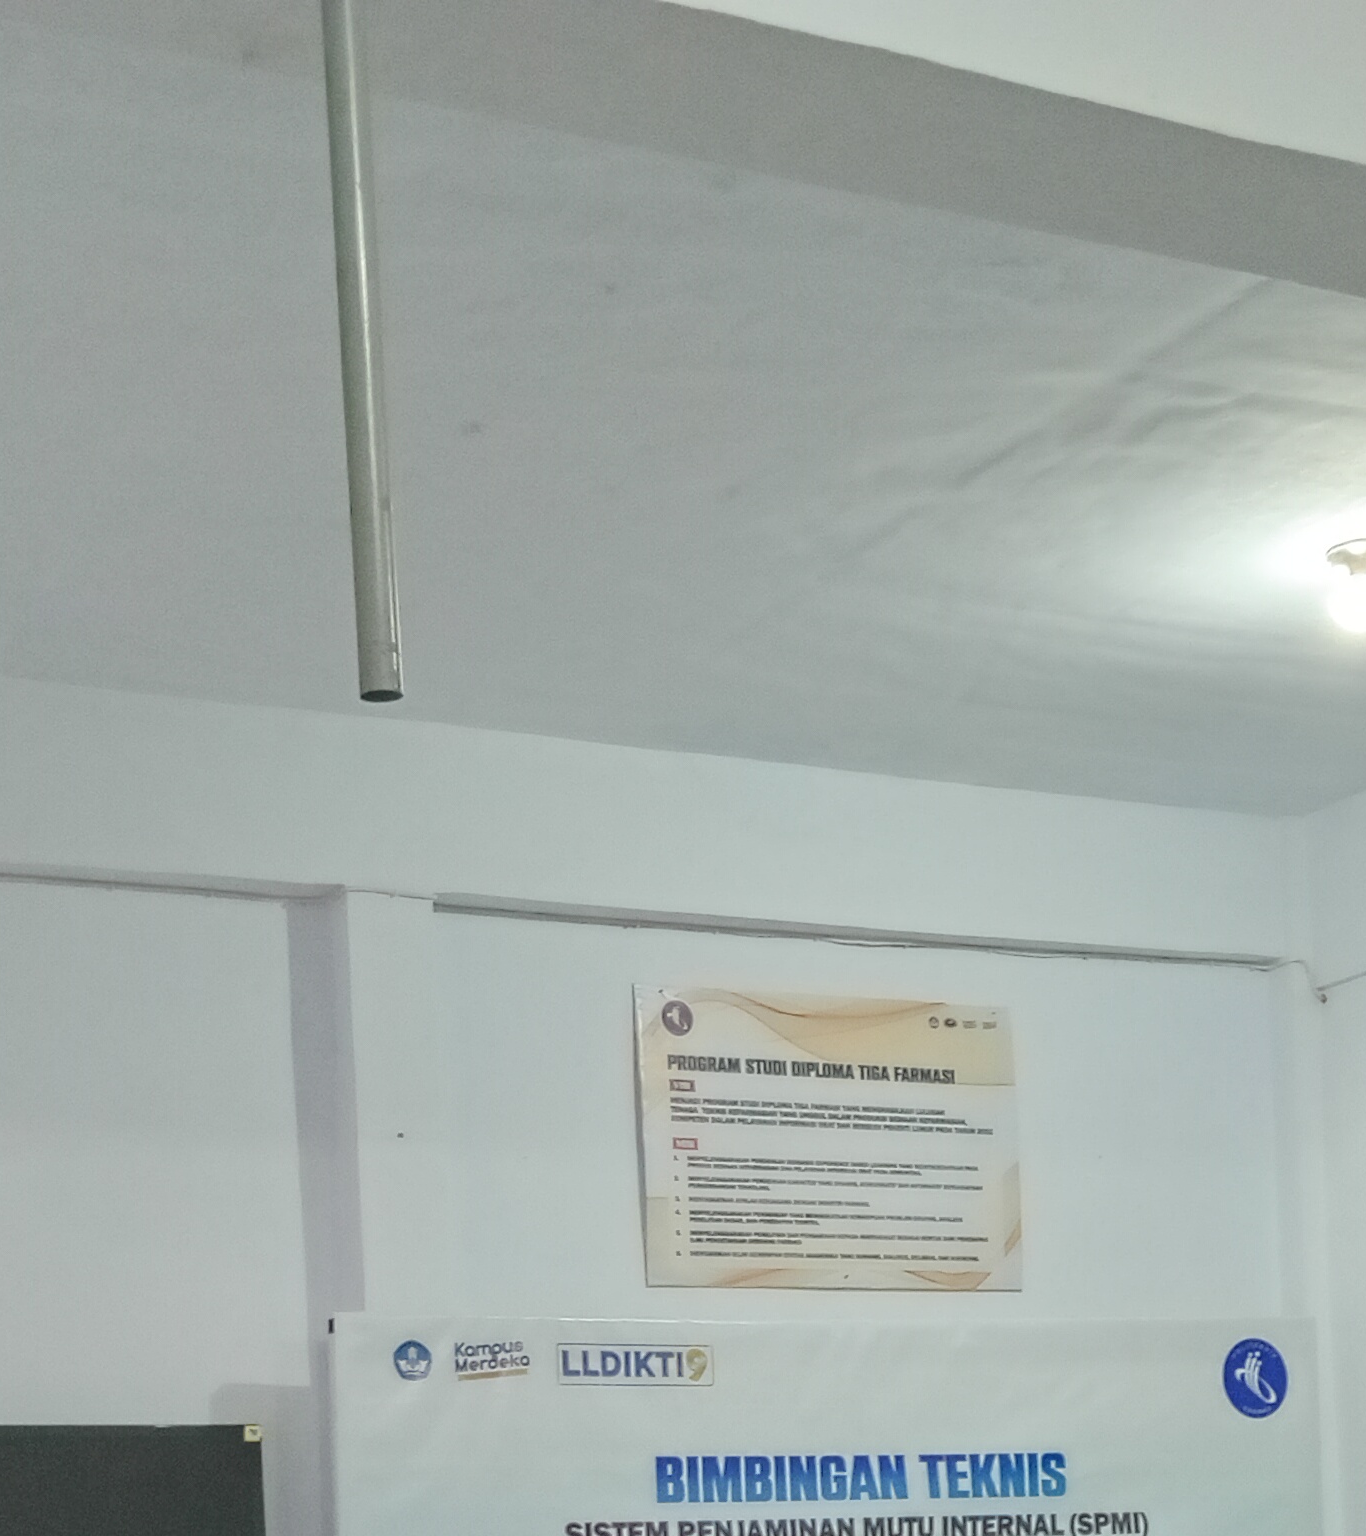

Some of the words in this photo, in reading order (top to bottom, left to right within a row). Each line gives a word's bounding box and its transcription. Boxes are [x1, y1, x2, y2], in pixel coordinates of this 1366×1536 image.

[667, 1054, 741, 1074] PROGRAM
[745, 1058, 788, 1077] STUDI
[791, 1061, 855, 1080] DIPLOMA
[857, 1064, 890, 1082] TIGA
[893, 1066, 956, 1085] FARMASI
[454, 1341, 524, 1360] Kampus
[455, 1354, 530, 1373] Merdeka
[655, 1454, 909, 1503] BIMBINGAN
[918, 1452, 1067, 1499] TEKNIS
